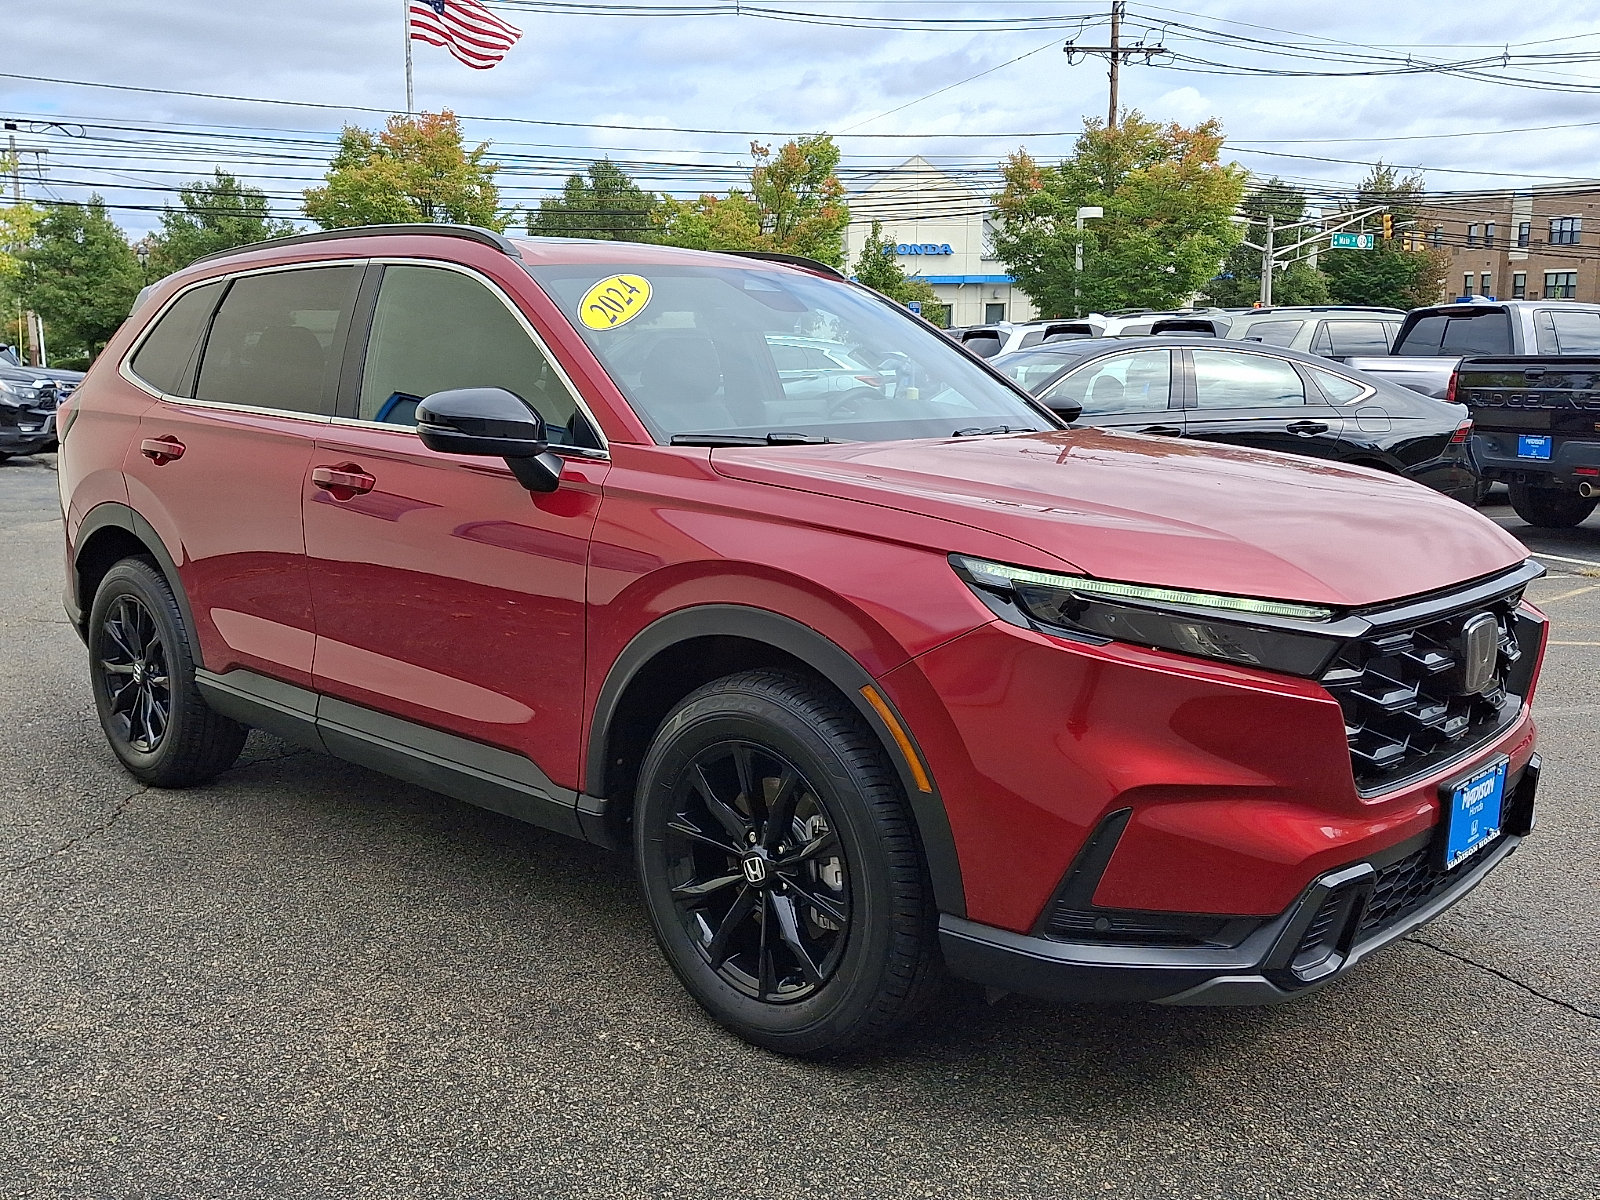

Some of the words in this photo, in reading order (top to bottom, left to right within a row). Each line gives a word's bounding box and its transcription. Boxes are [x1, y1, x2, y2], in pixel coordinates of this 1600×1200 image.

[590, 278, 640, 324] 2024
[1462, 777, 1495, 810] MADISON
[1447, 844, 1478, 871] MADISON
[1479, 829, 1500, 849] HONDA
